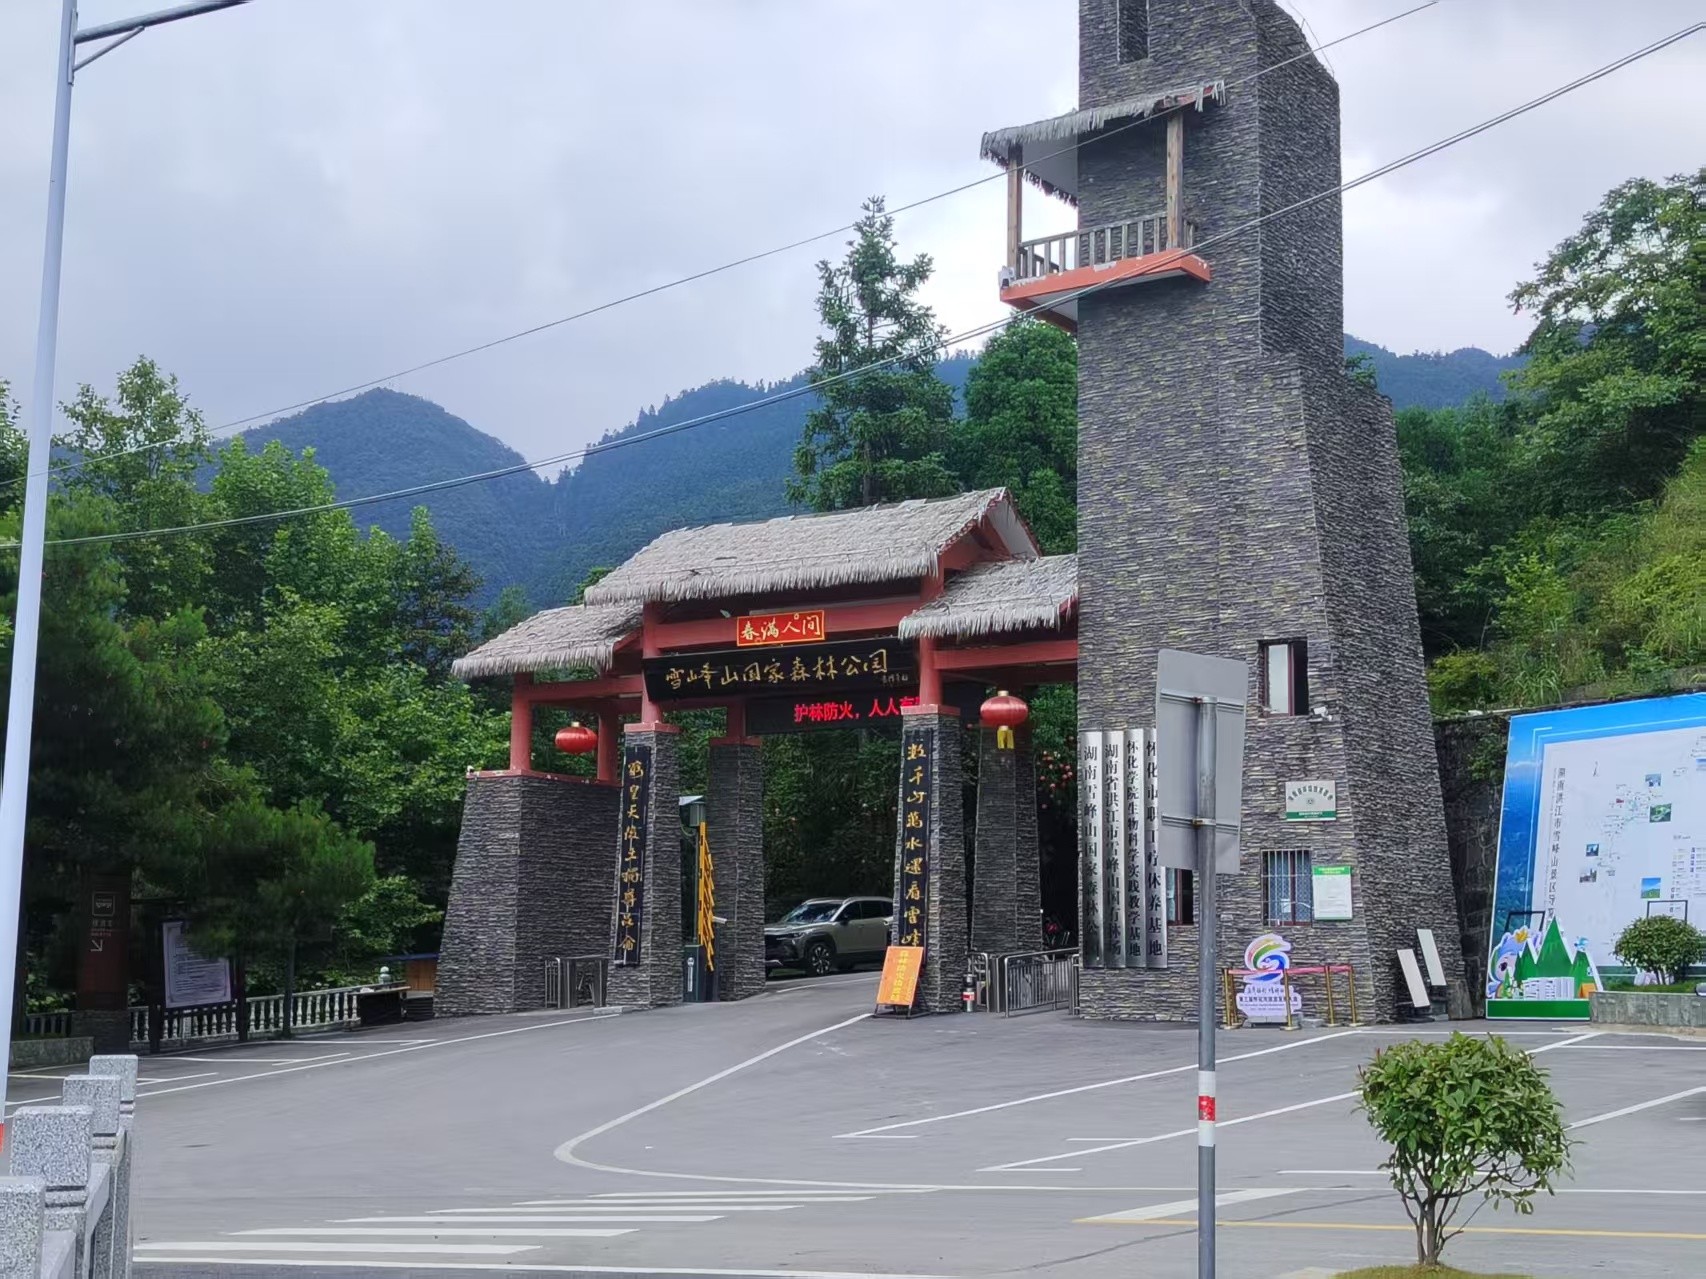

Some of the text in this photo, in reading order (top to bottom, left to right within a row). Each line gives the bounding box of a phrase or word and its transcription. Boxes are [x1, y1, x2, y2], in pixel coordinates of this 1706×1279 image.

[665, 648, 887, 689] 雪峰山国家森林公园
[741, 615, 820, 640] 春满人间
[794, 694, 920, 723] 护林防火，人人有
[1083, 745, 1099, 956] 湖南雪峰山国家森林公
[1104, 744, 1121, 956] 湖南省洪江市雪峰山国有林场
[1127, 740, 1141, 957] 怀化学院生物科学实践教学基地
